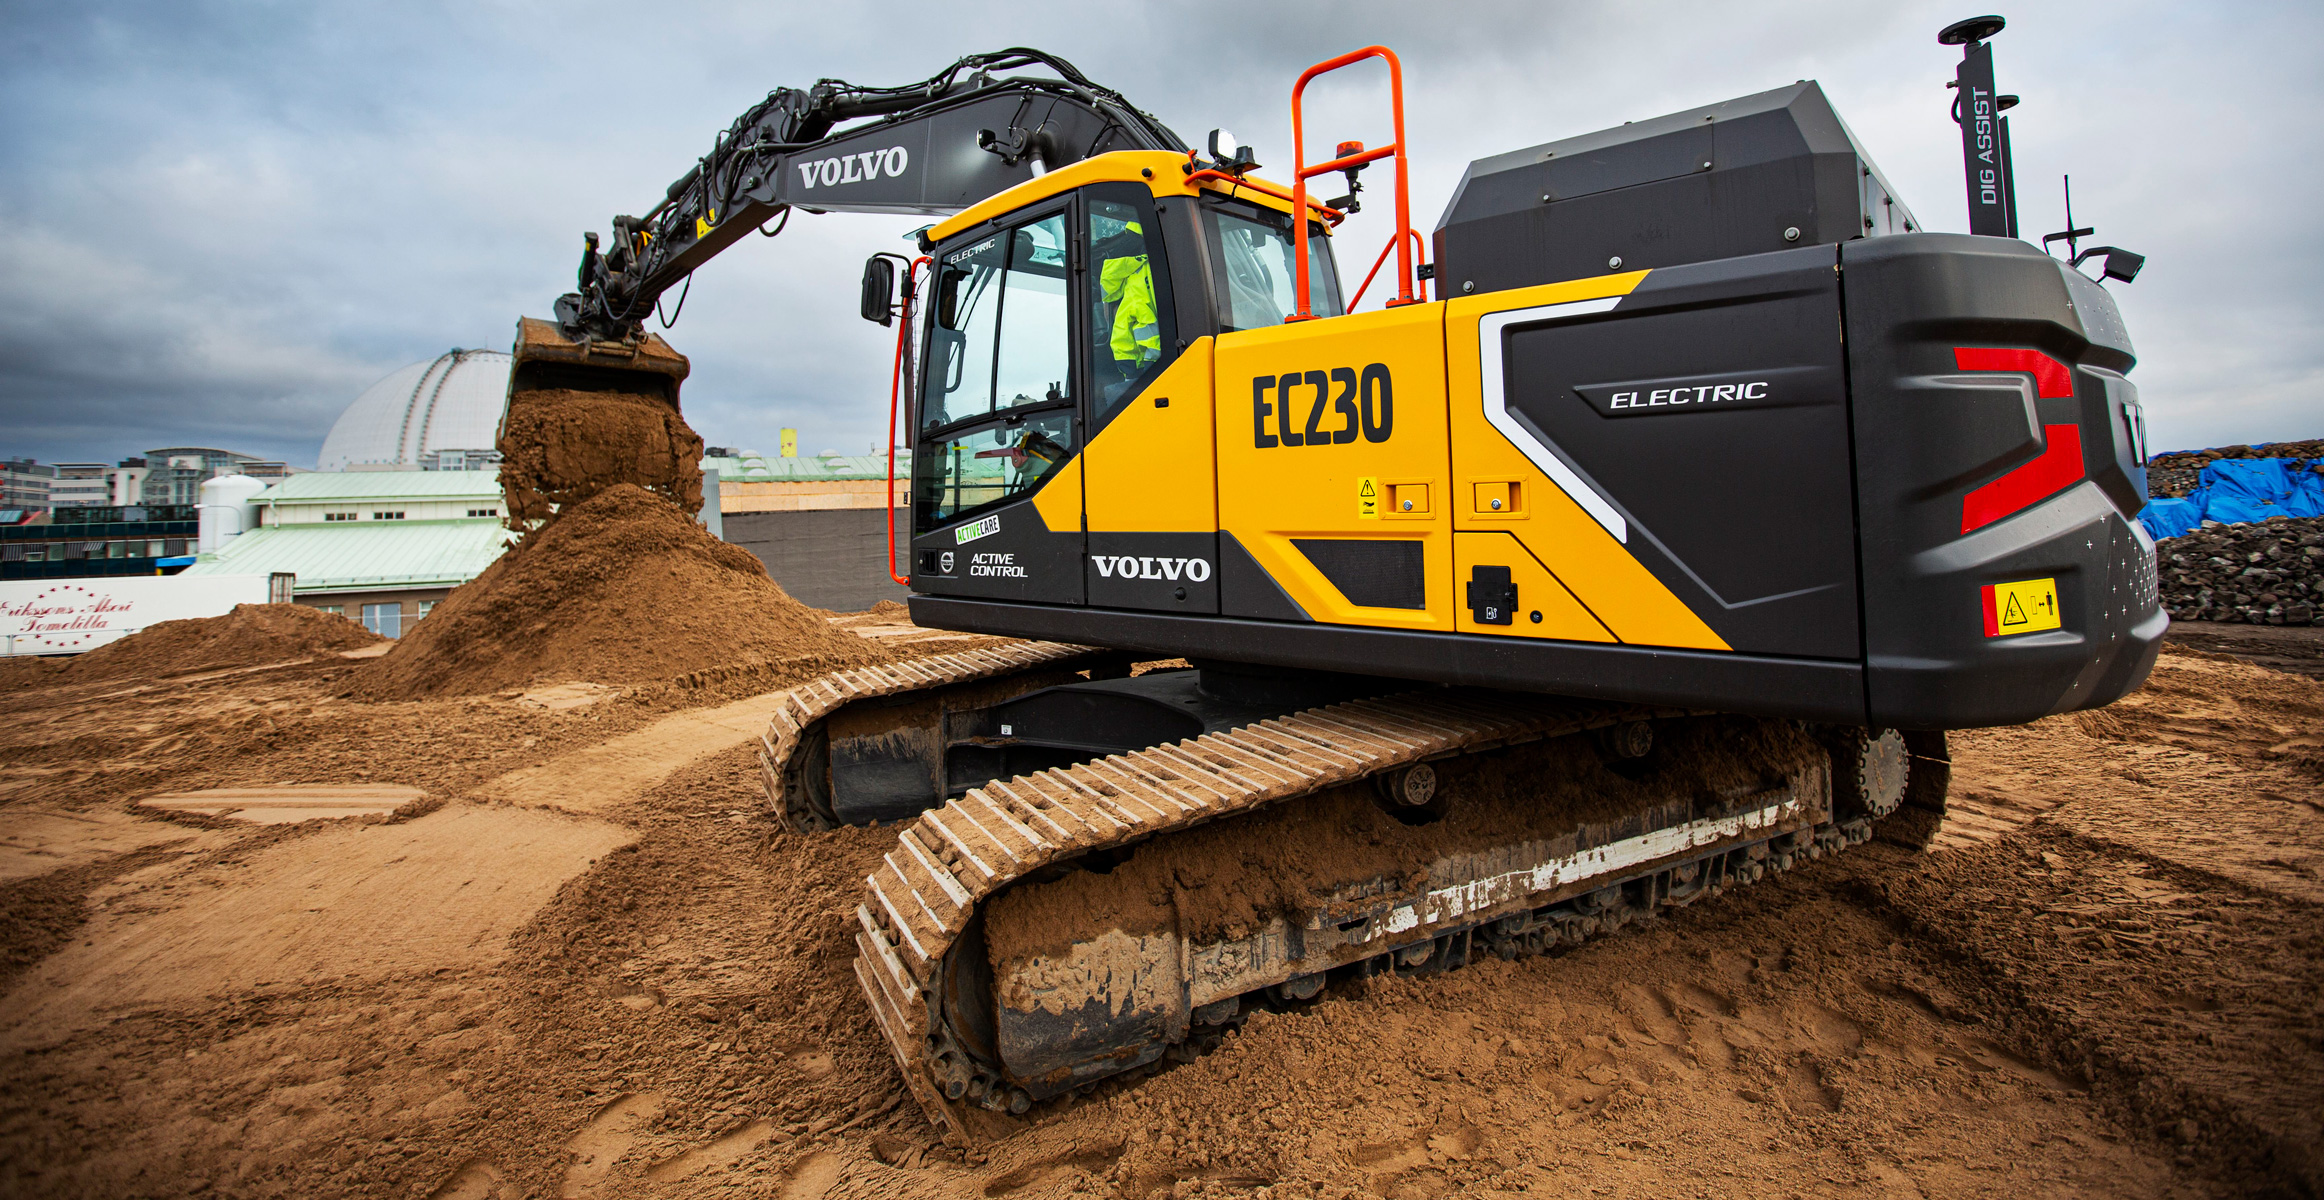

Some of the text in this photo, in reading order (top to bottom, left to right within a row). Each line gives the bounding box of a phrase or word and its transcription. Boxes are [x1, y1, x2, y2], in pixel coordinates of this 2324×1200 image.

[1973, 87, 1996, 204] DIG ASSIST
[798, 146, 908, 189] VOLVO
[951, 239, 995, 264] ELECTRIC
[1253, 363, 1393, 448] EC230
[1610, 382, 1768, 409] ELECTRIC
[957, 517, 998, 543] ACTIVECARE
[970, 565, 1028, 578] CONTROL
[971, 553, 1014, 565] ACTIVE
[1092, 556, 1211, 582] VOLVO
